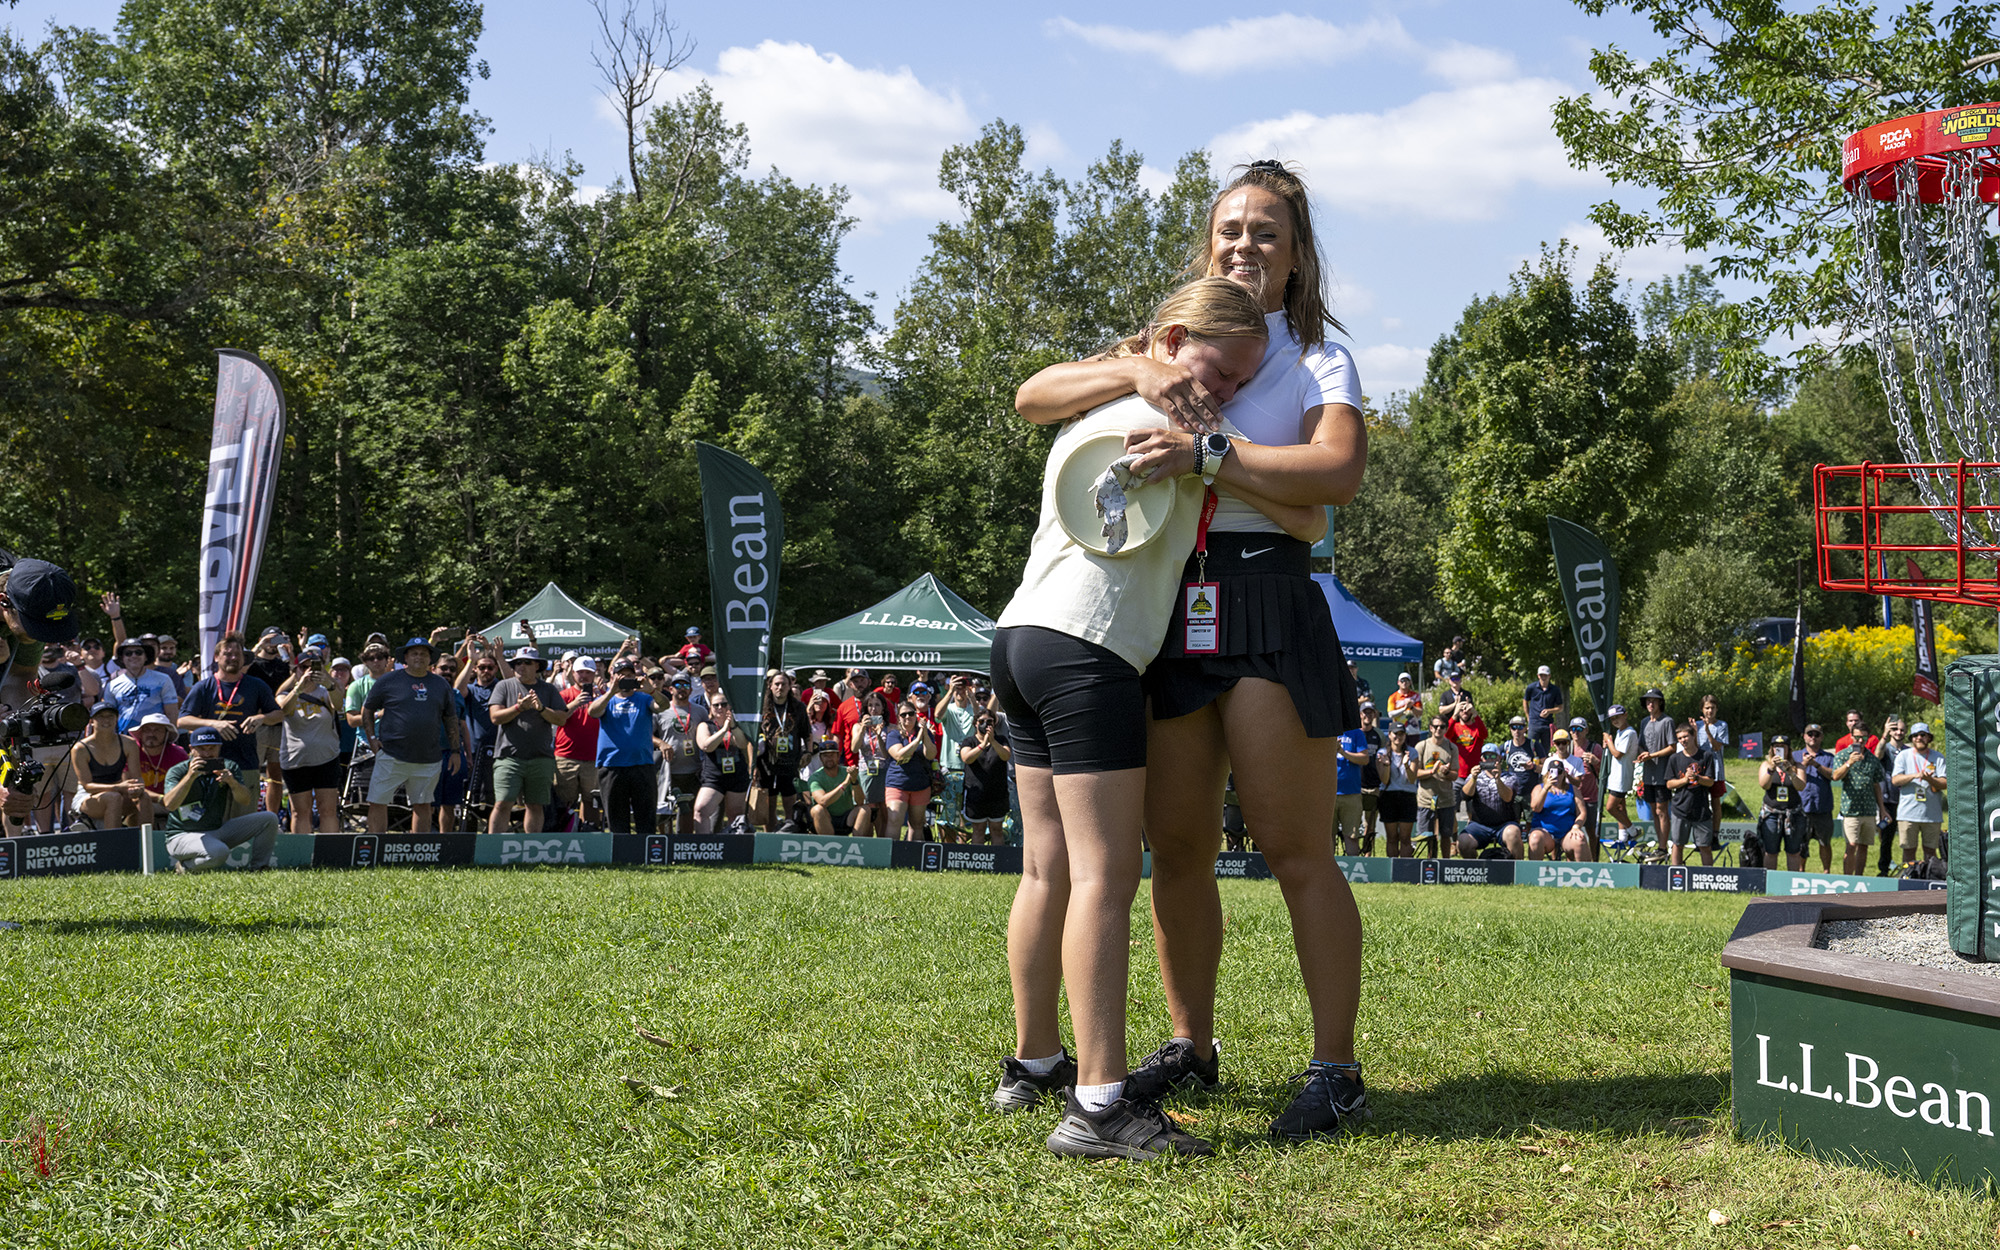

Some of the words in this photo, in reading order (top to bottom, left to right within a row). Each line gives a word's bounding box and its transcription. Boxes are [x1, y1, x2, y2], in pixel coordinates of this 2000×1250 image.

[1880, 128, 1912, 146] PDGA
[1884, 141, 1906, 151] MAJOR
[859, 612, 958, 631] L.L.Bean
[839, 643, 941, 663] llbean.com
[1356, 647, 1403, 657] GOLFERS
[26, 846, 60, 859] DISC
[62, 843, 97, 855] GOLF
[384, 843, 411, 853] DISC
[415, 843, 441, 853] GOLF
[500, 838, 587, 864] PDGA
[673, 843, 697, 852] DISC
[699, 843, 724, 852] GOLF
[383, 852, 440, 862] NETWORK
[673, 851, 723, 861] NETWORK
[779, 840, 864, 866] PDGA
[948, 852, 970, 861] DISC
[973, 853, 996, 862] GOLF
[26, 853, 97, 870] NETWORK
[947, 860, 994, 870] NETWORK
[1225, 860, 1247, 868] GOLF
[1214, 867, 1246, 875] TWORK
[1444, 867, 1464, 876] DISC
[1466, 868, 1489, 877] GOLF
[1444, 874, 1489, 883] NETWORK
[1537, 866, 1615, 888] PDGA
[1692, 874, 1714, 884] DISC
[1716, 874, 1739, 885] GOLF
[1692, 881, 1738, 891] NETWORK
[1790, 877, 1869, 896] PDGA
[1756, 1033, 1994, 1137] L.L.Bean
